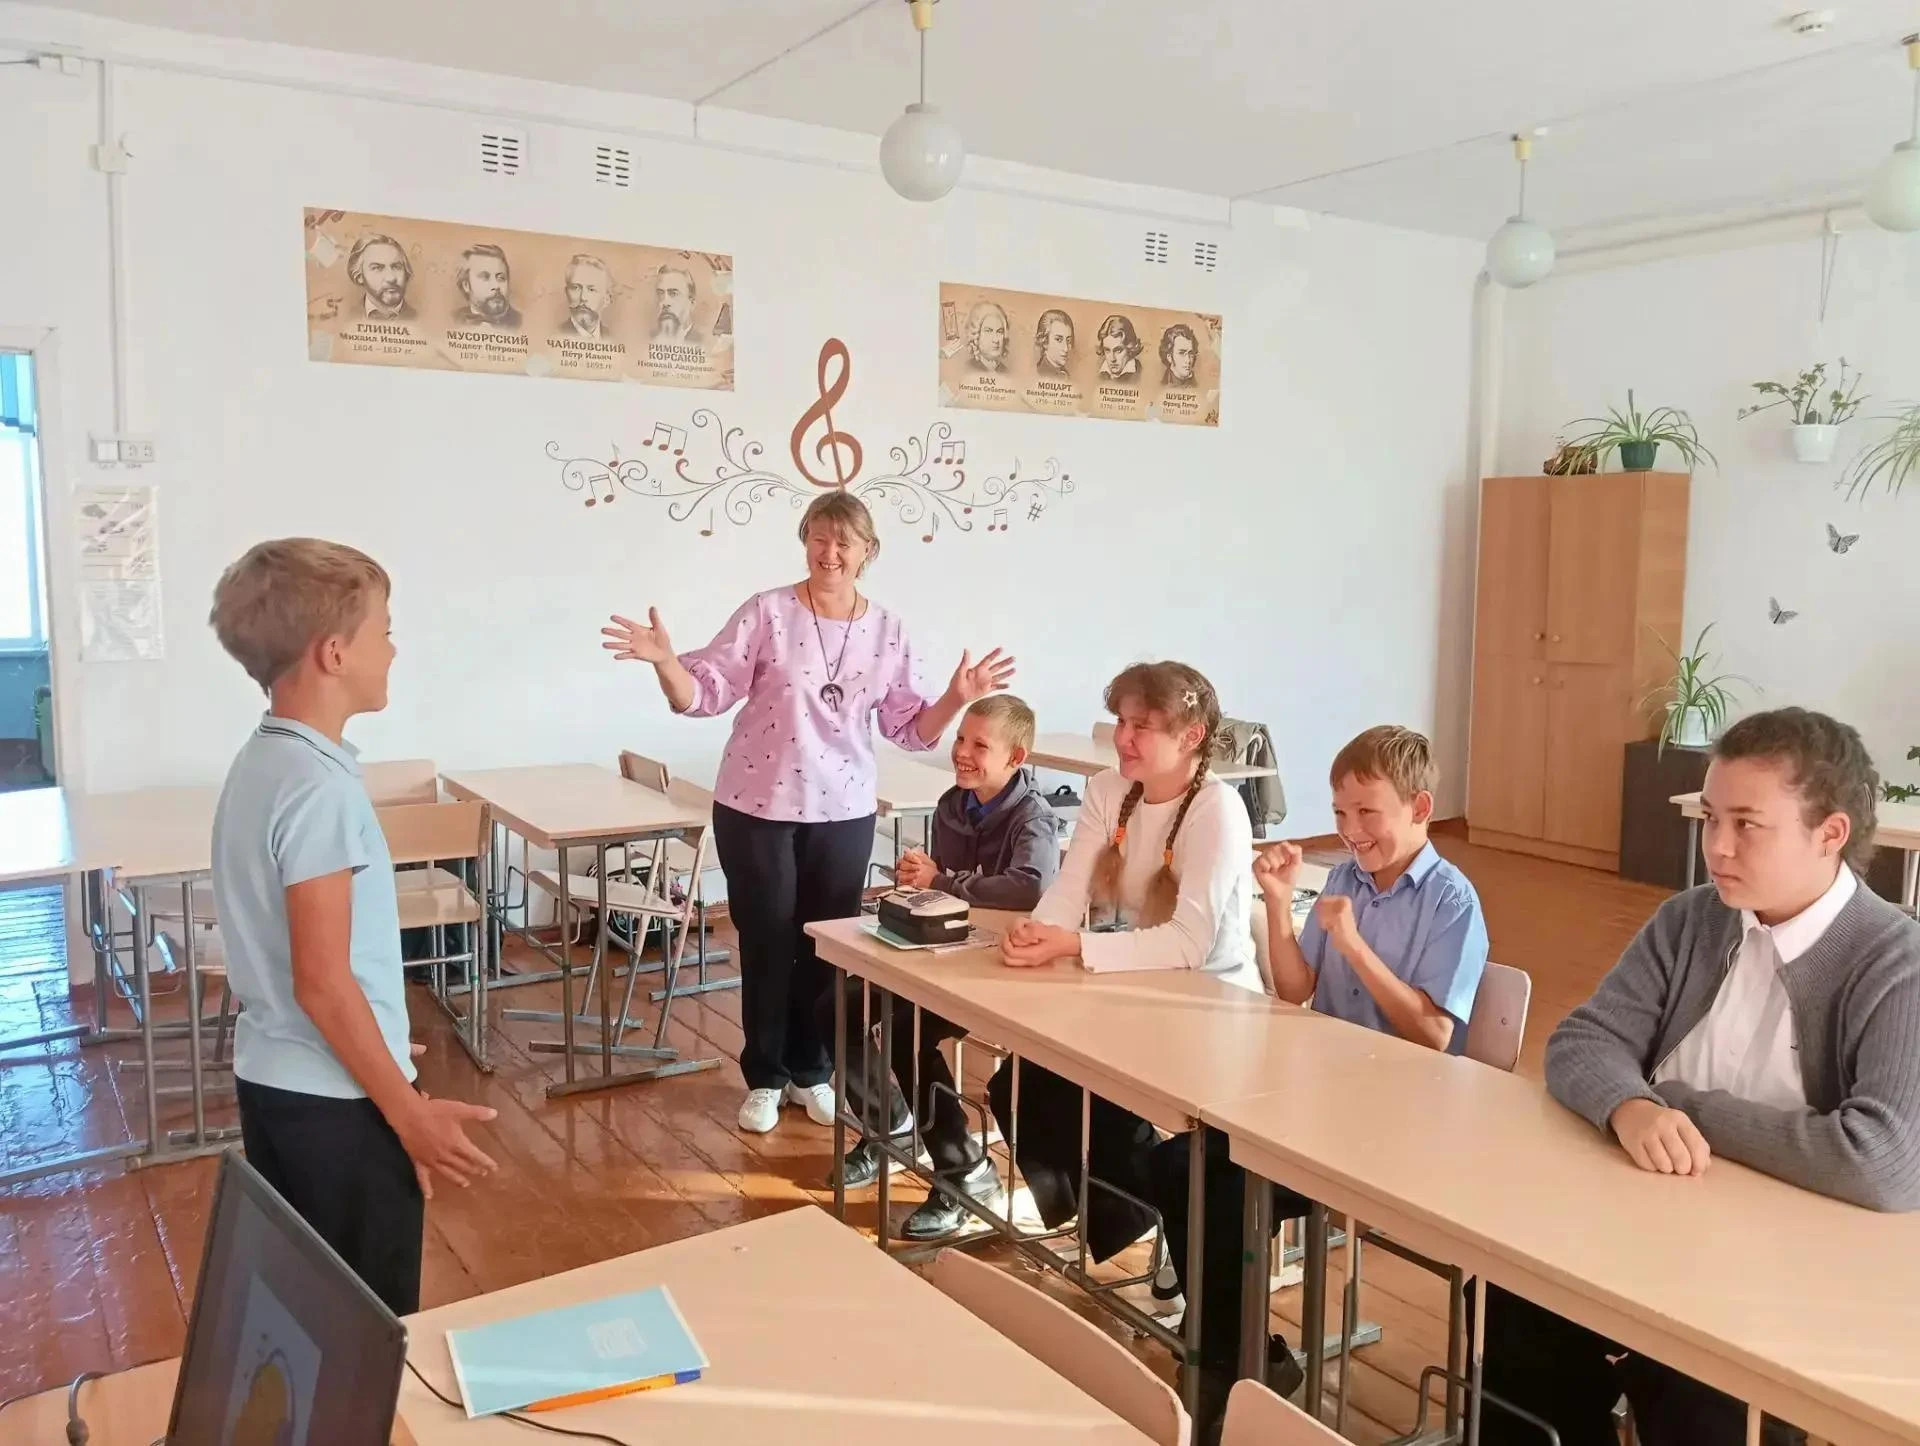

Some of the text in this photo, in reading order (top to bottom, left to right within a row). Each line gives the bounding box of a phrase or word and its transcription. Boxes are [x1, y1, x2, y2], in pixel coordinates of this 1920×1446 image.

[356, 323, 411, 336] ГЛИНКА
[339, 332, 428, 346] Михаил Иванович
[446, 330, 529, 346] МУСОРГСКИЙ
[448, 341, 483, 351] Модест
[546, 339, 627, 354] ЧАЙКОВСКИЙ
[648, 343, 706, 356] РИМСКИЙ-
[648, 351, 706, 364] КОРСАКОВ
[979, 376, 997, 386] БАХ
[1037, 381, 1073, 392] МОЦАРТ
[1099, 387, 1139, 398] БЕТХОВЕН
[1165, 393, 1197, 402] ШУБЕРТ
